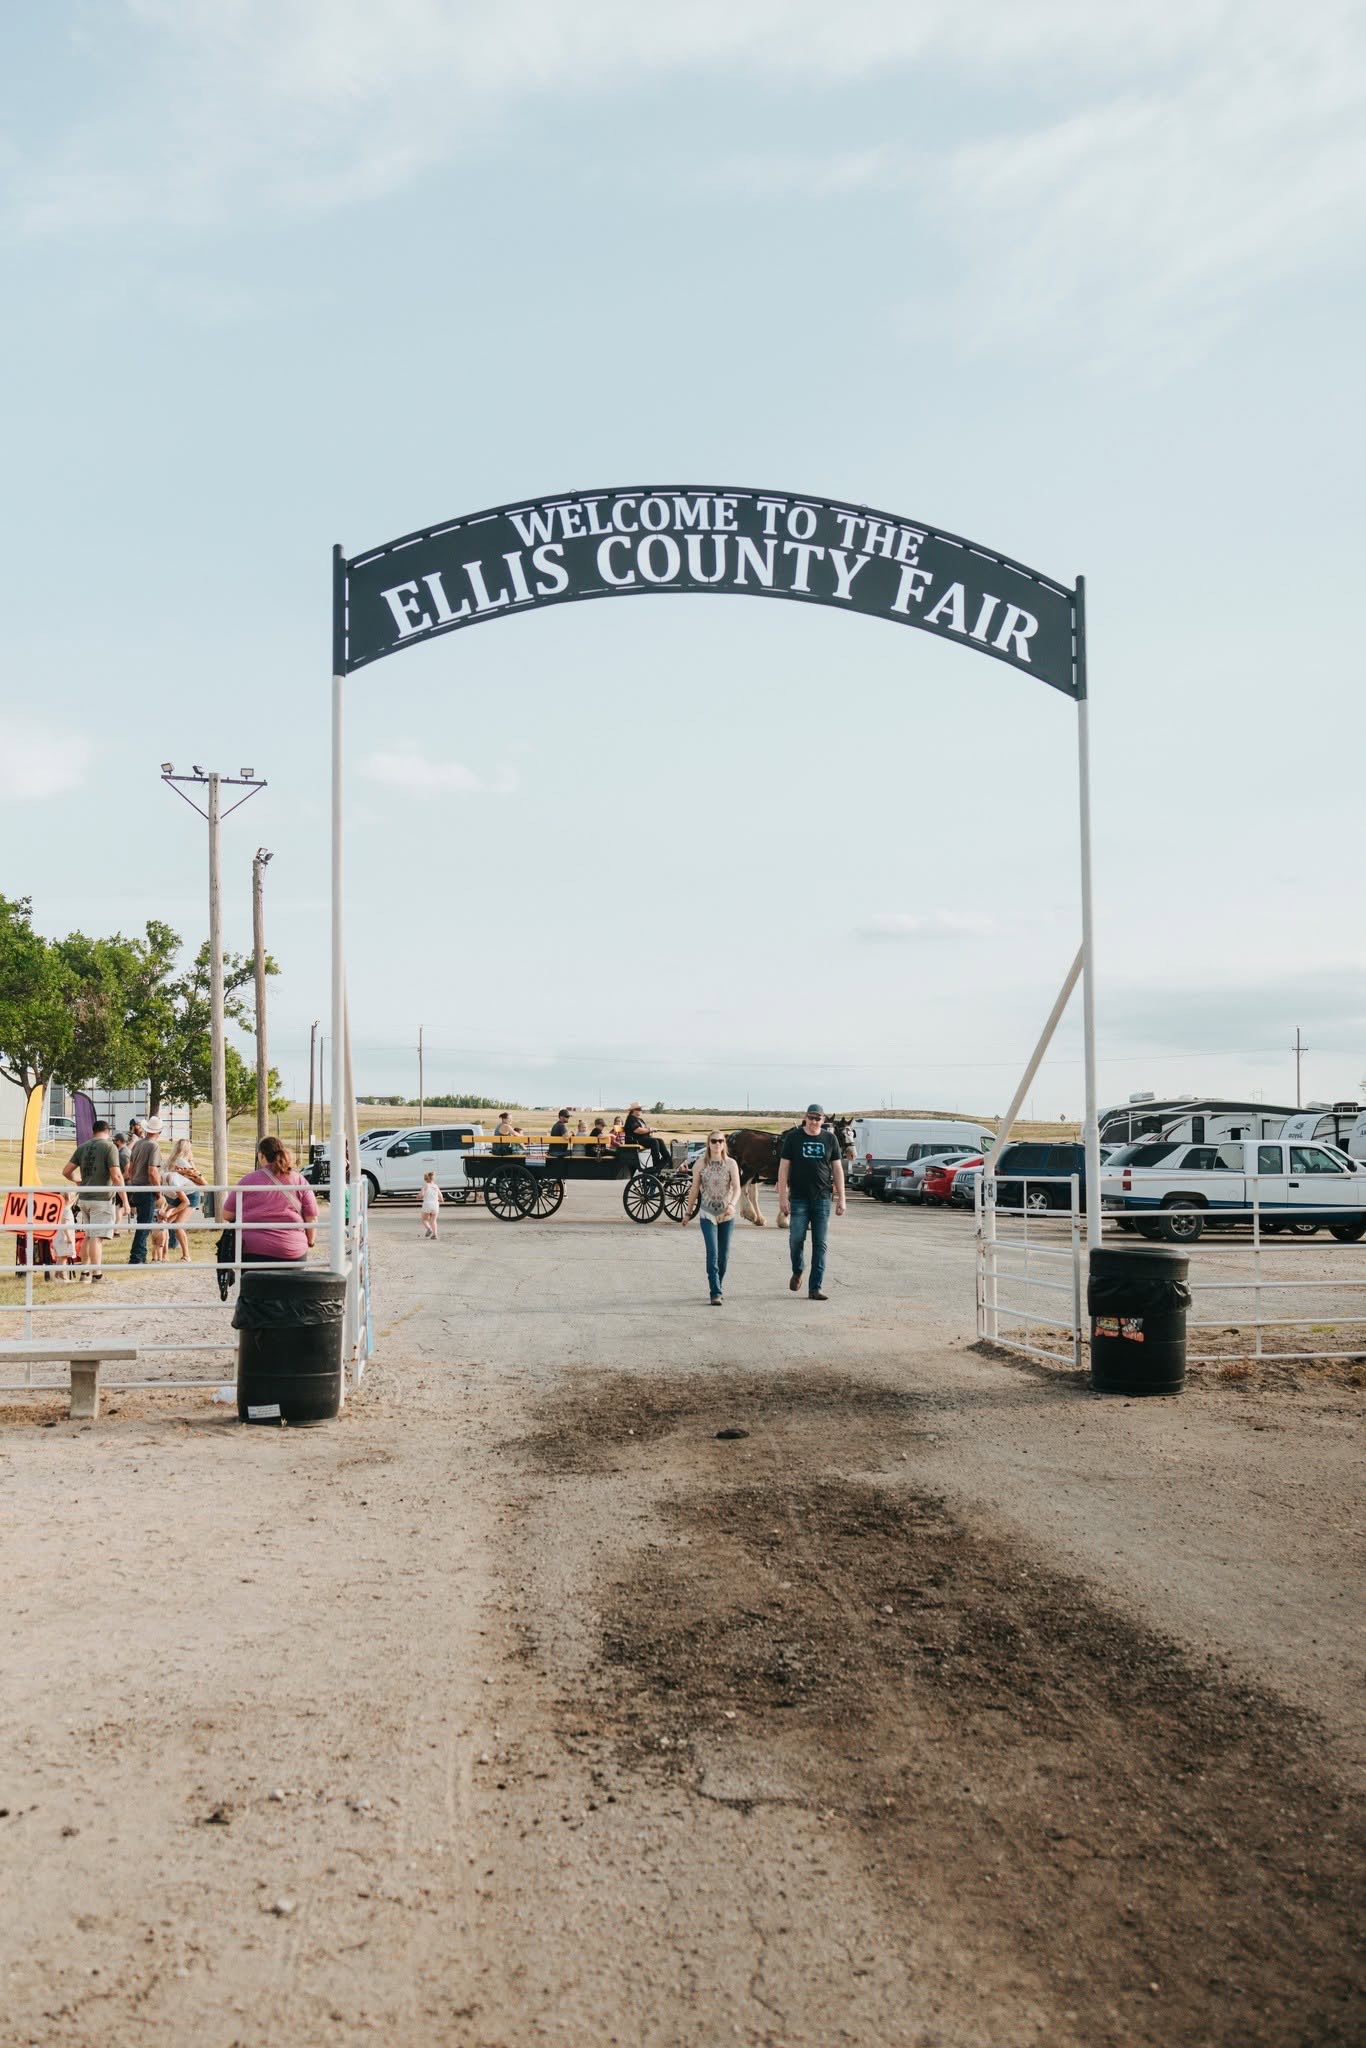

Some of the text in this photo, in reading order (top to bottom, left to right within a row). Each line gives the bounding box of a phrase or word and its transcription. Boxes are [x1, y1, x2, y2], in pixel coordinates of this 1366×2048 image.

[508, 497, 925, 567] WELCOME TO THE
[379, 533, 1039, 663] ELLIS COUNTY FAIR
